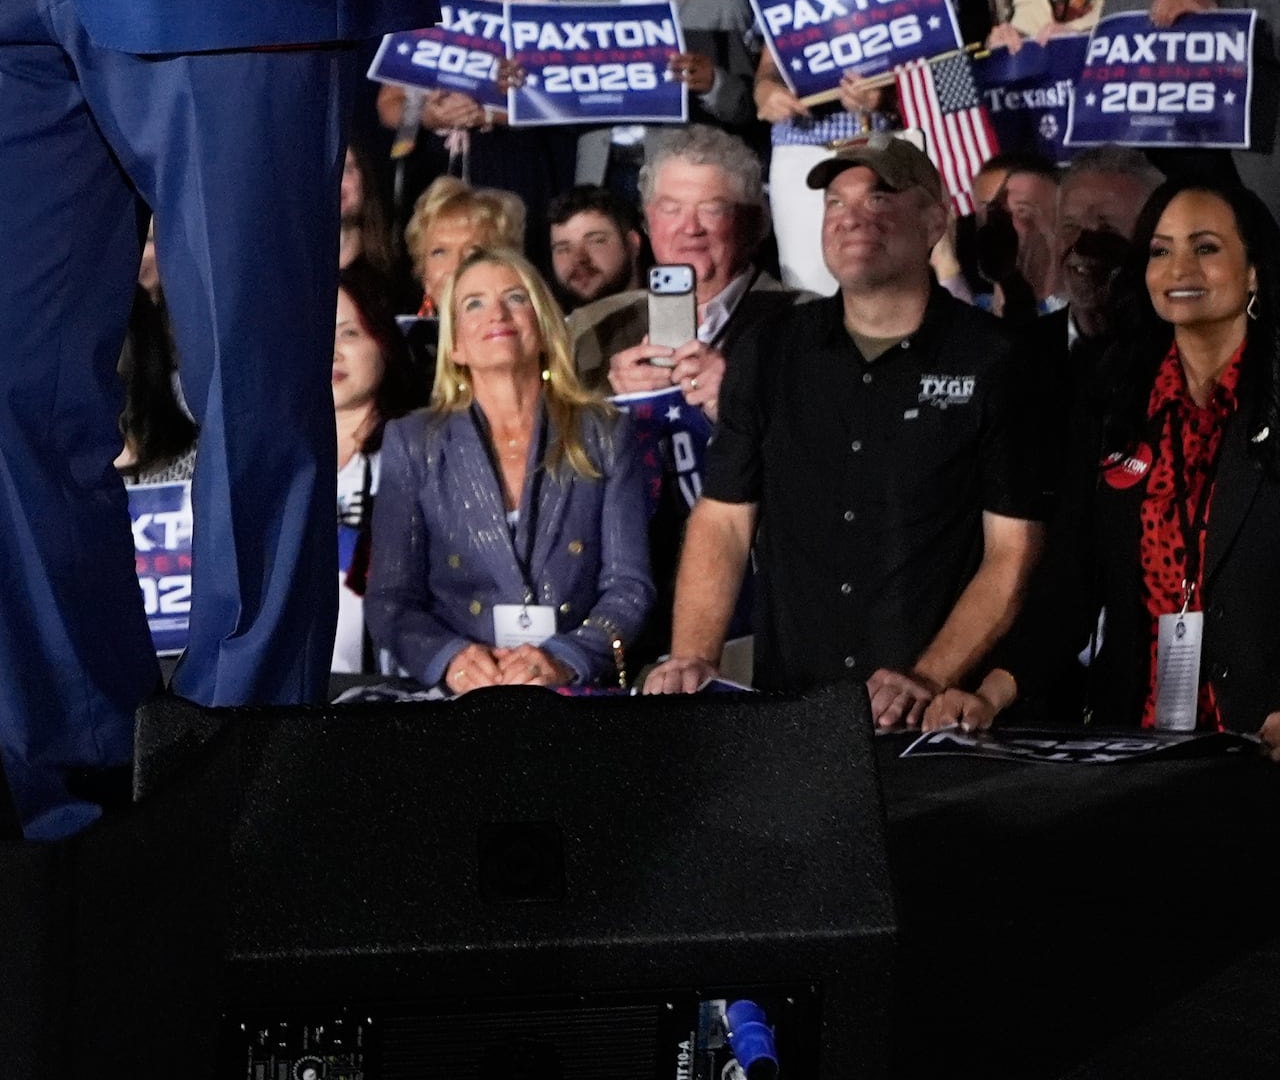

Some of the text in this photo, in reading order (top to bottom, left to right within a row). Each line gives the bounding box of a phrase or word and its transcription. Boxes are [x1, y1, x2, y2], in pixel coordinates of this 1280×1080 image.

[512, 19, 677, 51] PAXTON
[803, 14, 922, 74] 2026
[1085, 31, 1246, 66] PAXTON
[411, 39, 499, 80] 202
[542, 62, 658, 93] 2026
[1101, 82, 1216, 113] 2026
